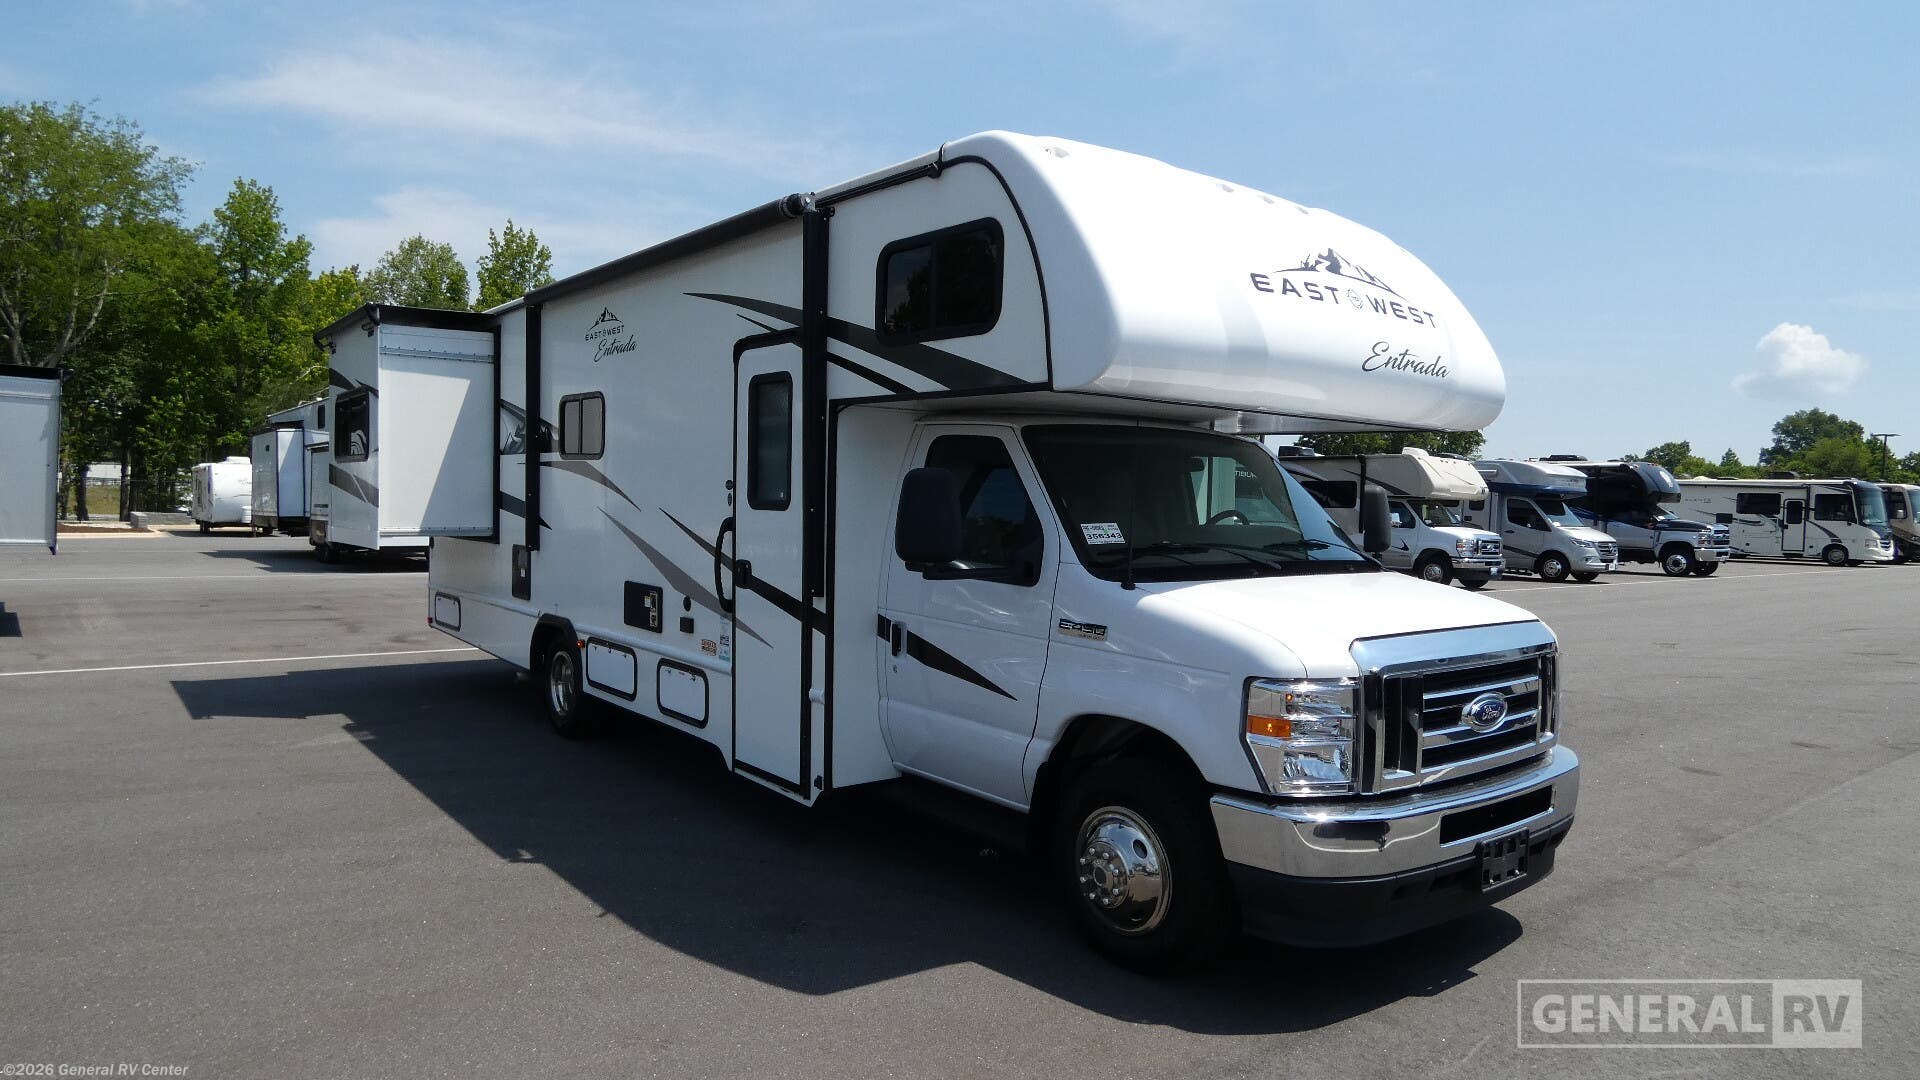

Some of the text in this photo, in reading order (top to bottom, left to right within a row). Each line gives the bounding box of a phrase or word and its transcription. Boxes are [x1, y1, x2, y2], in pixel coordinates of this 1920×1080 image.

[1250, 272, 1340, 305] EAST
[1365, 294, 1437, 329] WEST
[594, 334, 637, 363] Entrada
[1361, 341, 1449, 378] Entrada
